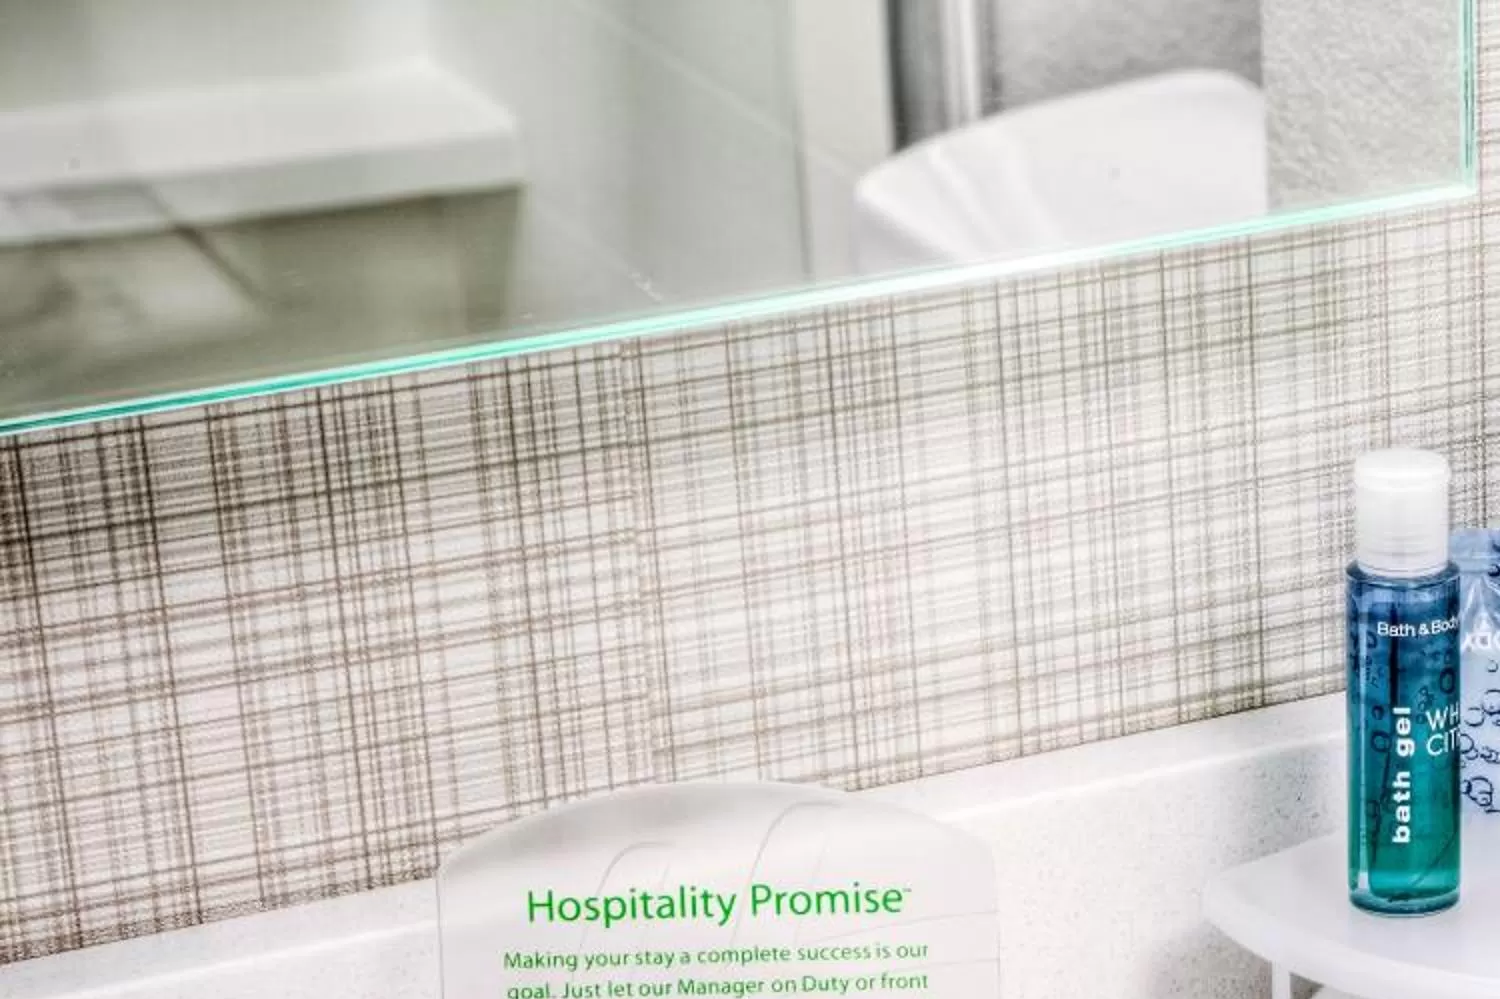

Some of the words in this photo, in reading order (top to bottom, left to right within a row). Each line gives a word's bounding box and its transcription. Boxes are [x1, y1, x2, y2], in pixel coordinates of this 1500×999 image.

[1377, 621, 1416, 637] Bath
[1418, 622, 1430, 635] &
[1393, 707, 1415, 757] gel
[1392, 770, 1411, 844] bath
[528, 886, 736, 928] Hospitality
[504, 952, 578, 972] Making
[585, 954, 629, 970] your
[635, 951, 674, 968] stay
[680, 952, 691, 964] a
[697, 947, 790, 966] complete
[798, 947, 871, 960] success
[876, 944, 891, 959] is
[896, 945, 928, 958] our
[562, 983, 600, 999] Just
[608, 981, 633, 997] let
[639, 983, 672, 997] our
[678, 979, 764, 998] Manager
[771, 980, 796, 992] on
[802, 976, 849, 994] Duty
[856, 978, 876, 991] or
[881, 973, 927, 989] front
